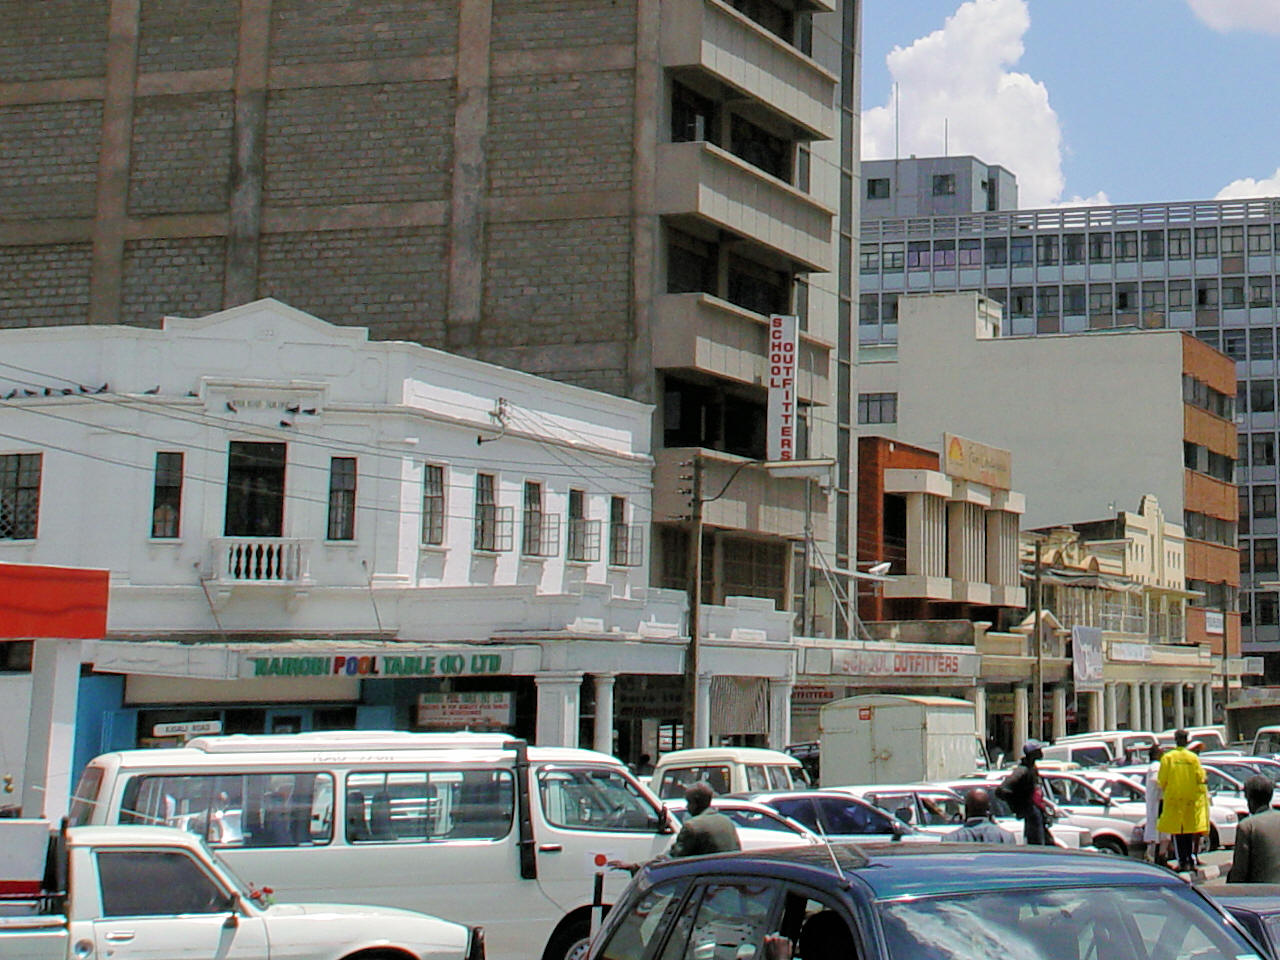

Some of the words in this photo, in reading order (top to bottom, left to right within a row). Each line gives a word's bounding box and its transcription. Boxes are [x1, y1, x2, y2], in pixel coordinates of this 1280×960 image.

[770, 318, 782, 388] SCHOOL
[780, 342, 793, 461] OUTFITTERS
[249, 656, 331, 676] NAIROBI
[333, 656, 379, 675] POOL
[383, 655, 436, 675] TABLE
[440, 654, 465, 674] (K)
[471, 654, 502, 674] LTD
[894, 654, 959, 673] OUTFITTERS
